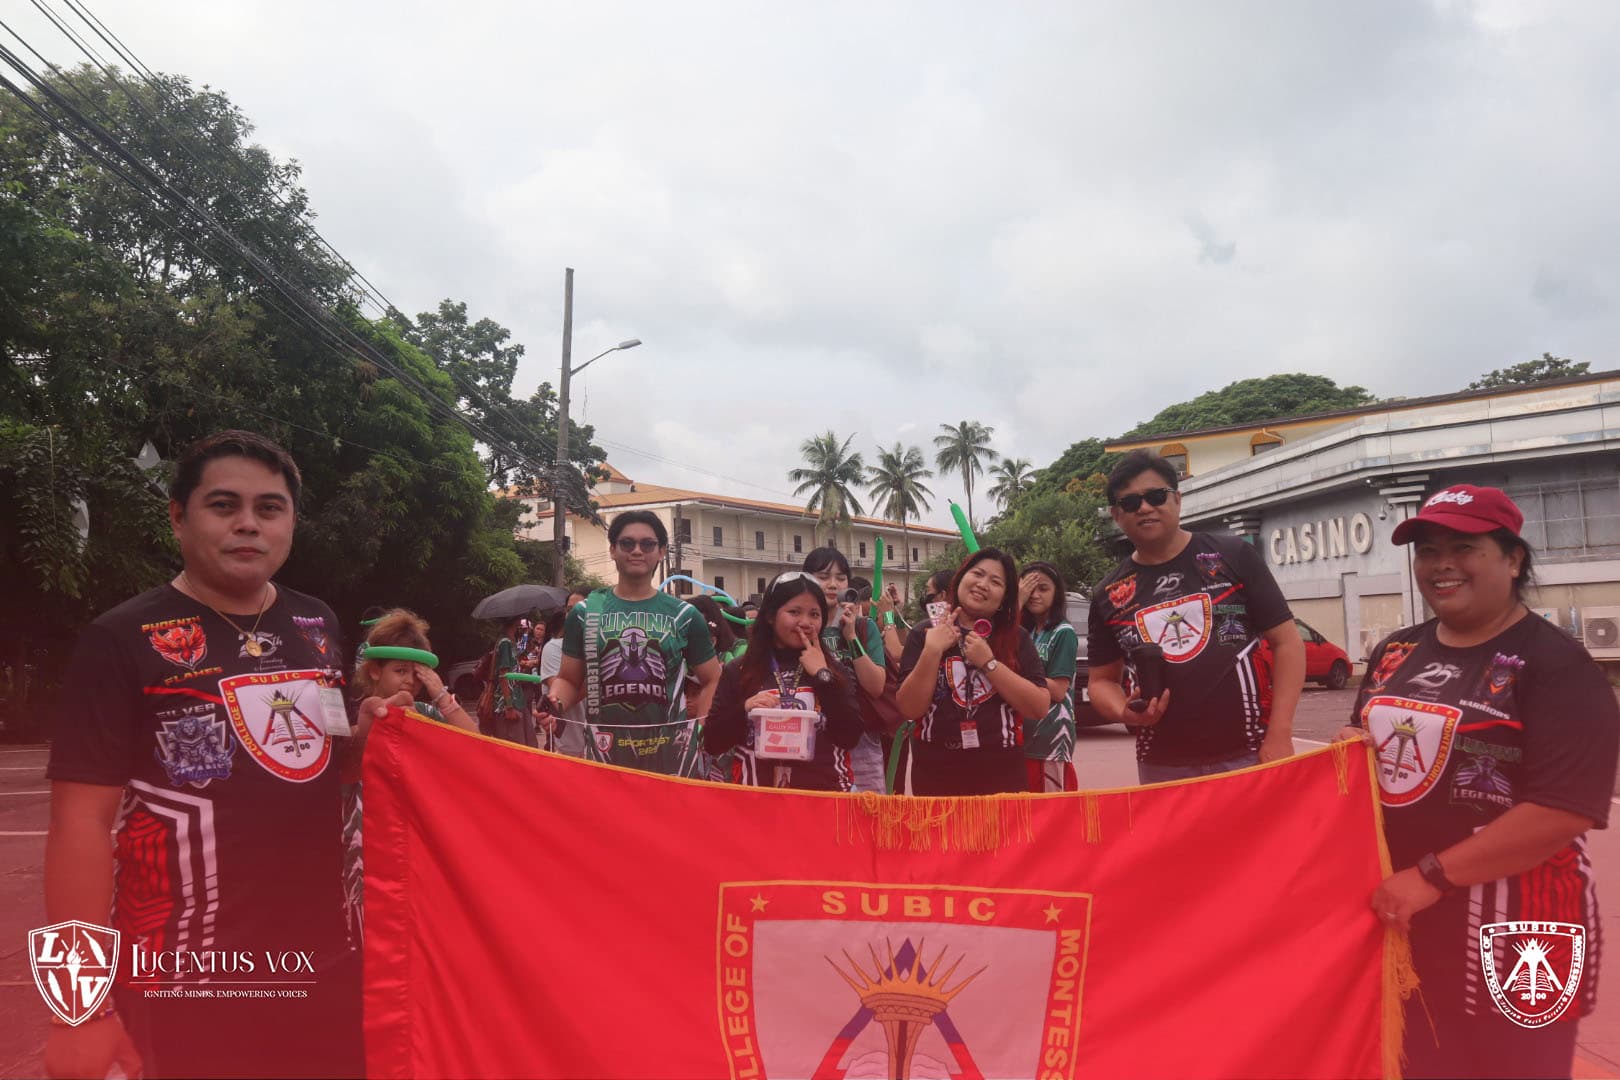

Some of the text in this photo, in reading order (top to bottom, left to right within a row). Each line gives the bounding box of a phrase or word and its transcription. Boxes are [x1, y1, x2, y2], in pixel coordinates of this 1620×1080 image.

[1270, 512, 1375, 566] CASINO
[600, 611, 677, 638] UMINA
[249, 672, 301, 683] SUBIC
[585, 612, 600, 715] LUMINA LEGENDS
[601, 683, 667, 699] EGEND
[225, 690, 258, 751] COLLEGE OF
[1394, 699, 1439, 713] SUBIC
[1459, 699, 1511, 720] WARRIORS
[1427, 717, 1456, 782] MONTESSORI
[1453, 787, 1513, 809] LEGENDS
[822, 890, 997, 922] SUBIC
[724, 913, 760, 1080] LLEGE OF
